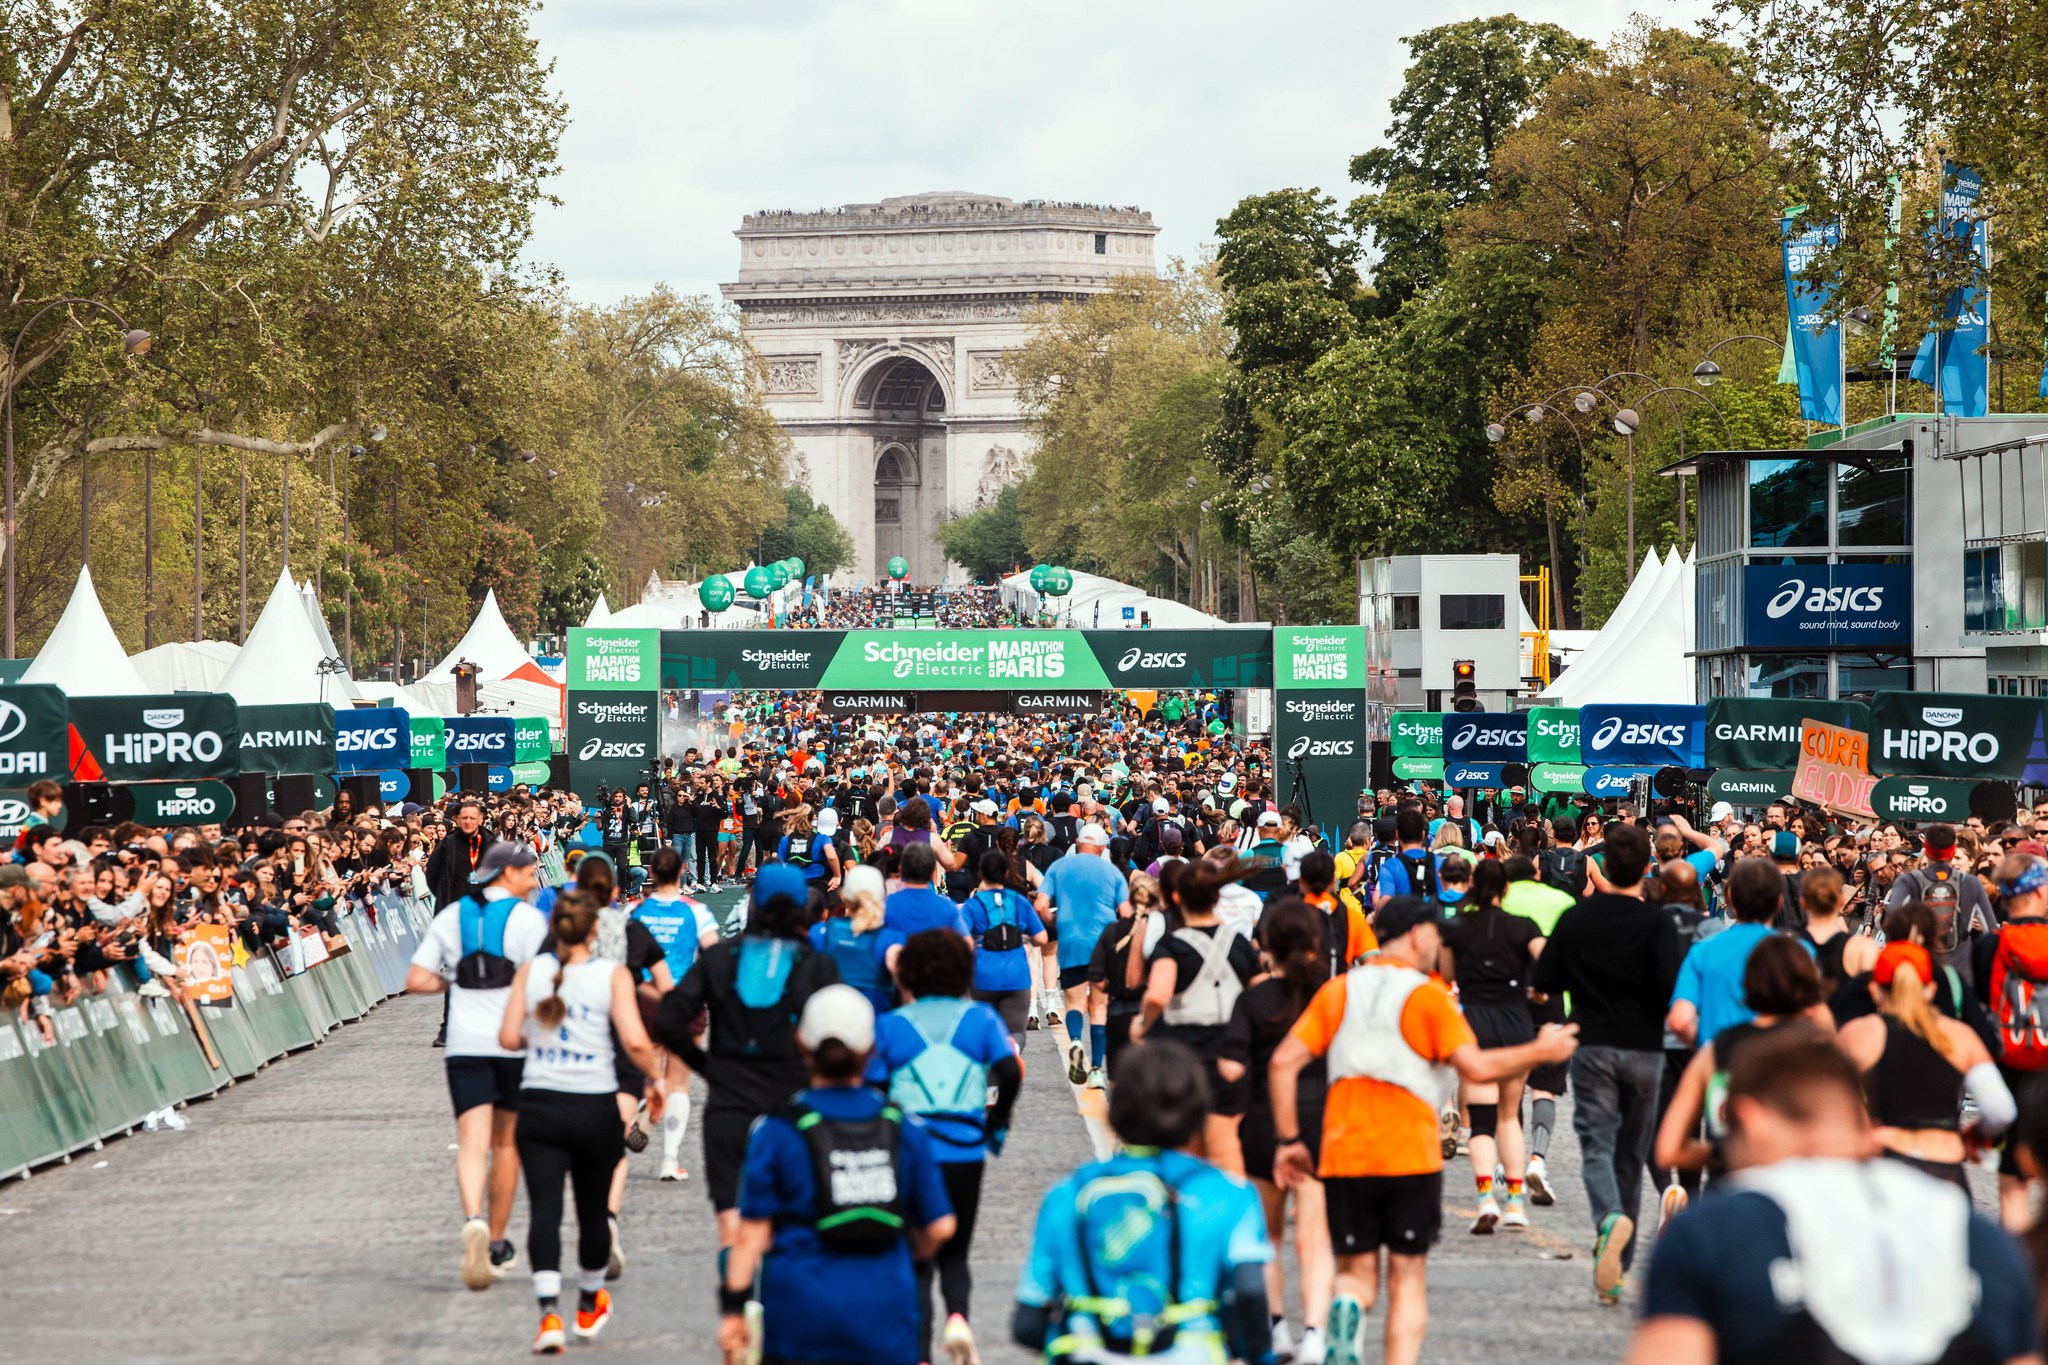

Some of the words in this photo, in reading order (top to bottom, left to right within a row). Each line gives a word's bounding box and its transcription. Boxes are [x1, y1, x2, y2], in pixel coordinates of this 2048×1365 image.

[764, 584, 771, 594] C
[1057, 578, 1069, 590] D
[722, 591, 731, 603] A
[1805, 587, 1884, 612] asics
[1799, 620, 1826, 630] sound
[1826, 620, 1849, 631] mind,
[1850, 620, 1877, 629] sound
[1878, 619, 1901, 630] body
[586, 637, 641, 647] Schneider
[1292, 635, 1347, 646] Schneider
[742, 650, 811, 662] Schneider
[864, 641, 984, 662] Schneider
[988, 640, 1064, 660] MARATHON
[586, 656, 641, 670] MARATHON
[772, 662, 810, 670] Electric
[996, 652, 1065, 678] PARIS
[1140, 652, 1187, 668] asics
[1293, 653, 1347, 668] MARATHON
[591, 663, 641, 682] PARIS
[916, 662, 984, 676] Electric
[1298, 661, 1348, 680] PARIS
[578, 702, 648, 715] Schneider
[1286, 700, 1355, 713] Schneider
[608, 714, 647, 722] Electric
[1315, 712, 1354, 720] Electric
[1398, 723, 1443, 736] Schne
[1620, 724, 1686, 746] asics
[336, 728, 398, 752] asics
[454, 733, 506, 751] asics
[1476, 730, 1528, 746] asics
[105, 730, 223, 764] HiPRO
[600, 742, 646, 758] asics
[1310, 740, 1354, 756] asics
[1883, 729, 1999, 763] HiPRO
[1466, 772, 1490, 780] asics
[1542, 772, 1582, 781] Schneider
[157, 798, 216, 817] HiPRO
[1889, 795, 1947, 814] HiPRO
